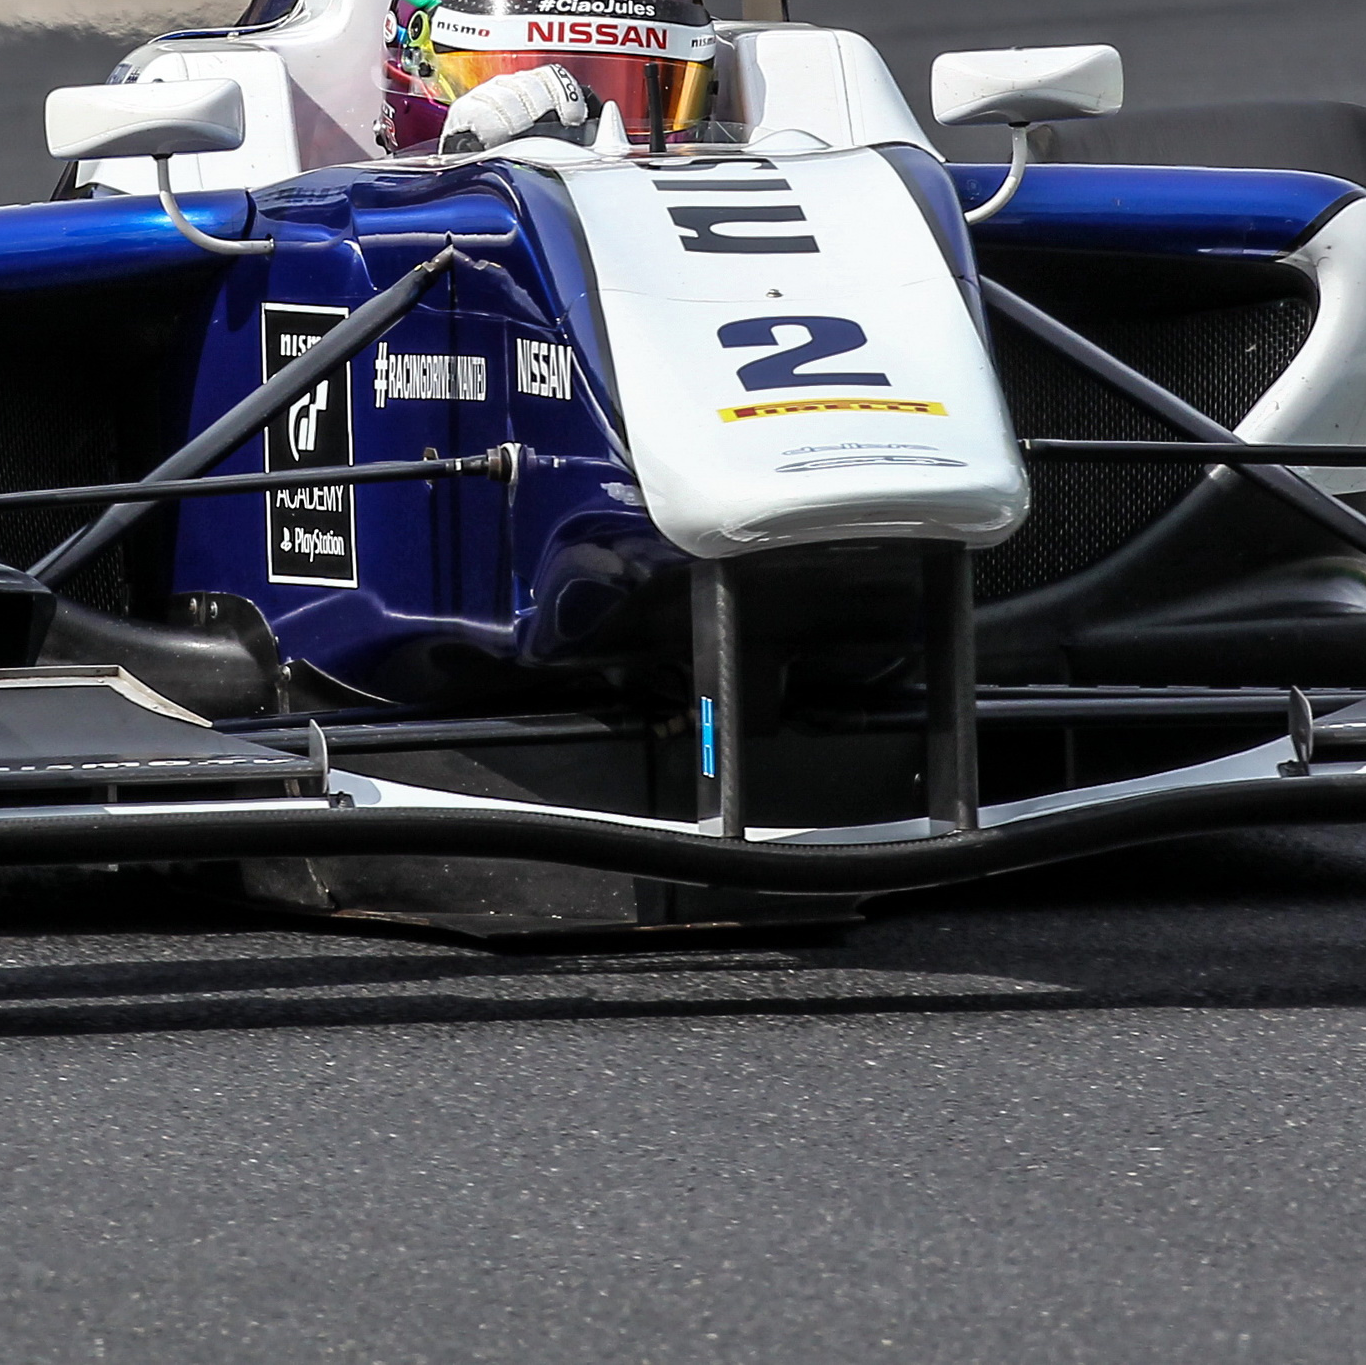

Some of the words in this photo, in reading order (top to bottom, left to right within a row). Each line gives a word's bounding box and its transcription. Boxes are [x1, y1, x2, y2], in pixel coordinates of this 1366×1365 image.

[436, 20, 490, 38] nismo
[527, 21, 668, 50] NISSAN
[517, 338, 572, 400] NISSAN
[717, 315, 892, 392] 2
[276, 484, 344, 512] ACADEMY
[295, 527, 345, 563] PlayStation
